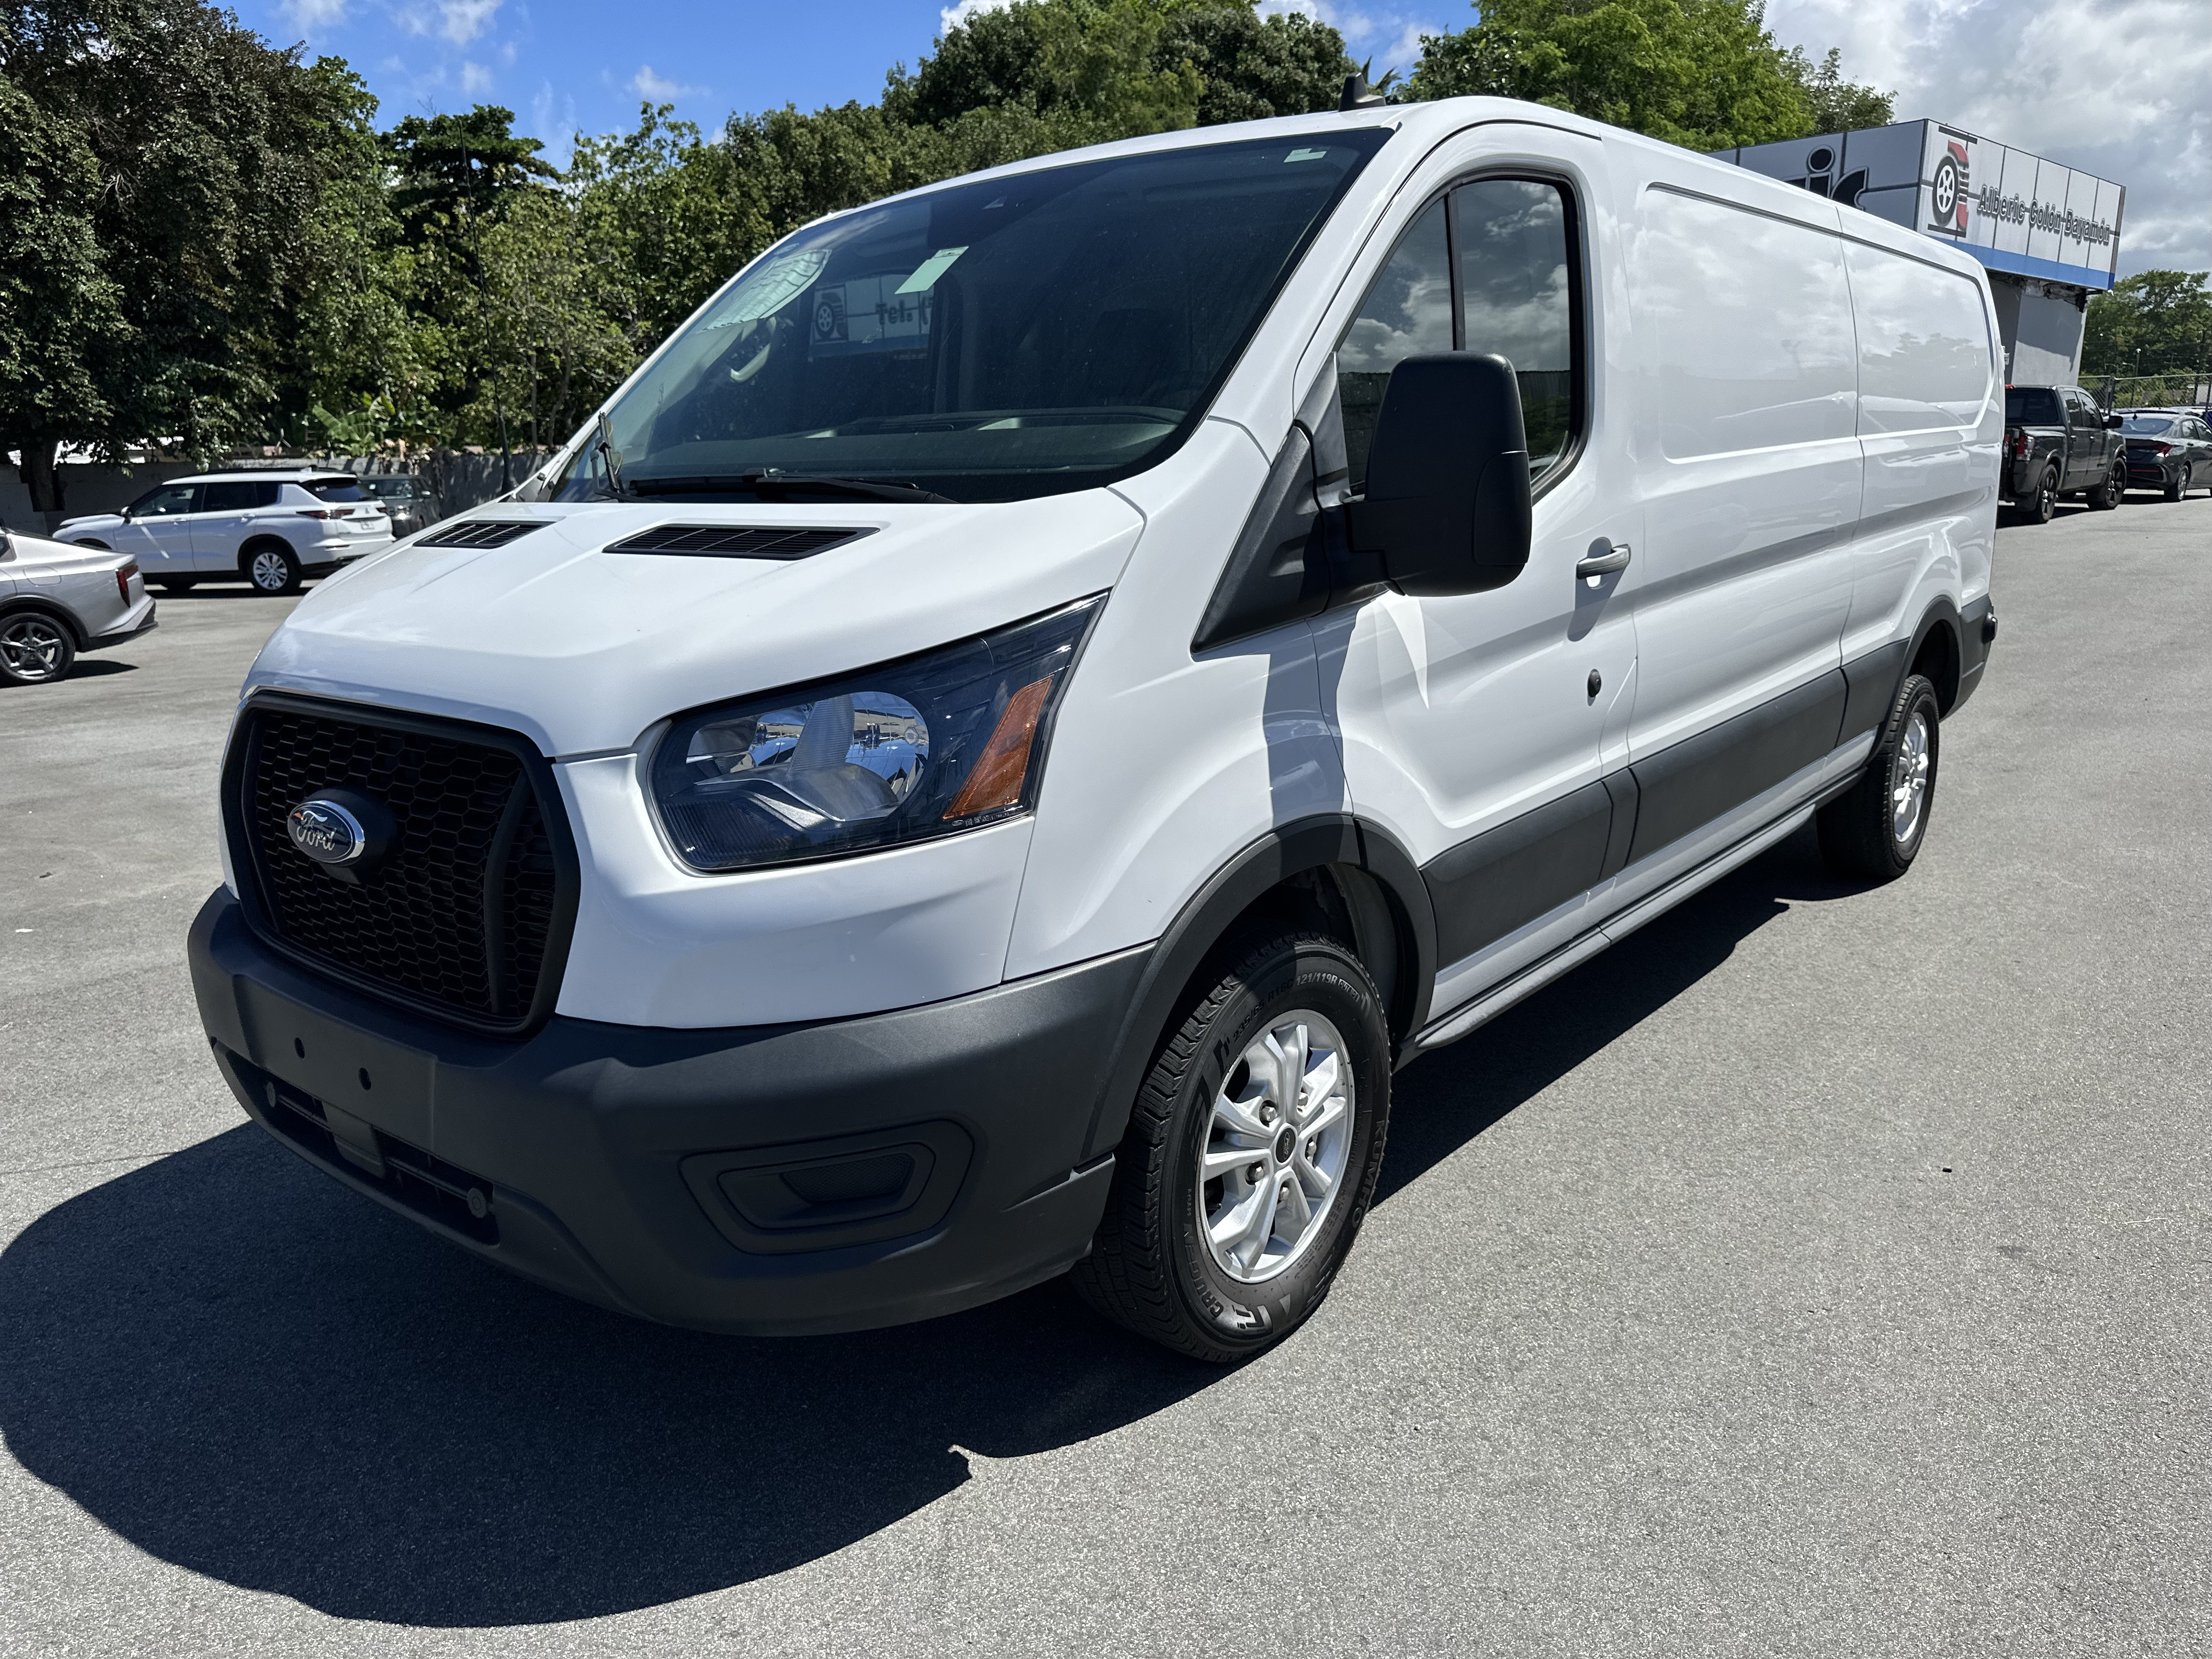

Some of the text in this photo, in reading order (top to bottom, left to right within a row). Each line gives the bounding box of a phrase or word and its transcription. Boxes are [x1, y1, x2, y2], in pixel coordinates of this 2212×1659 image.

[1977, 184, 2111, 244] Alberic Colón Bayamón
[876, 300, 913, 325] Tel.
[296, 810, 336, 851] Ford
[1233, 972, 1338, 1042] 235/65 R16C 121/119R
[1339, 979, 1359, 1002] OUTSIDE
[1352, 1120, 1385, 1228] KUMHO
[1183, 1223, 1224, 1318] CRUGEN
